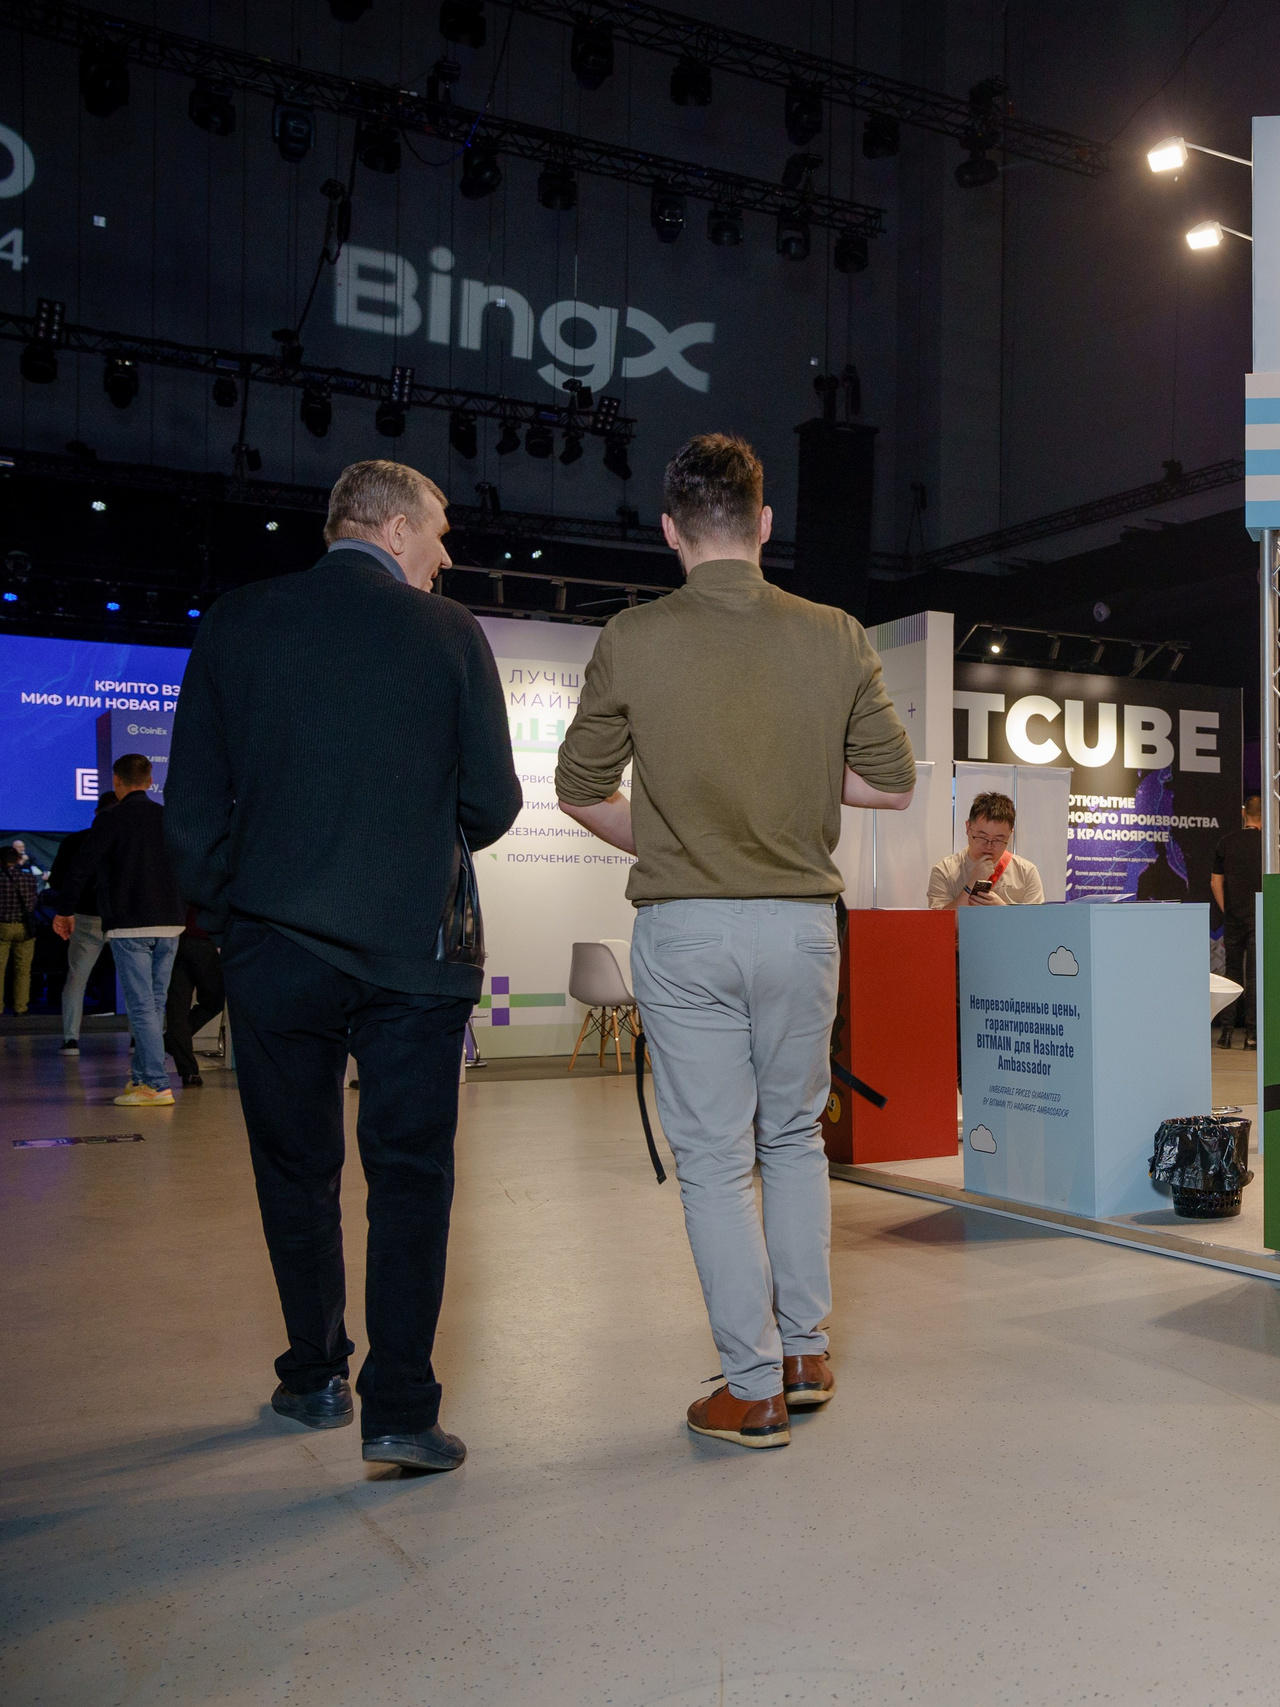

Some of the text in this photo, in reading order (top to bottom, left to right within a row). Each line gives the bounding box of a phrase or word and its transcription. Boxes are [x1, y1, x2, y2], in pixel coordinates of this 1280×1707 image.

[95, 680, 159, 695] КРИПТО
[21, 692, 63, 706] МИФ
[66, 695, 101, 708] ИЛИ
[105, 698, 159, 712] НОВАЯ
[140, 726, 167, 735] CoinEx
[518, 775, 554, 784] ЕРВИС
[1068, 794, 1136, 808] ОТКРЫТИЕ
[1068, 811, 1219, 828] НОВОГО ПРОИЗВОДСТВА
[1077, 829, 1169, 842] КРАСНОЯРСКЕ
[507, 853, 580, 864] ПОЛУЧЕНИЕ
[969, 994, 1080, 1020] Непревзойденные цены,
[985, 1018, 1064, 1036] гарантированные
[976, 1033, 1074, 1058] BITMAIN для Hashrate
[998, 1055, 1051, 1076] Ambassador
